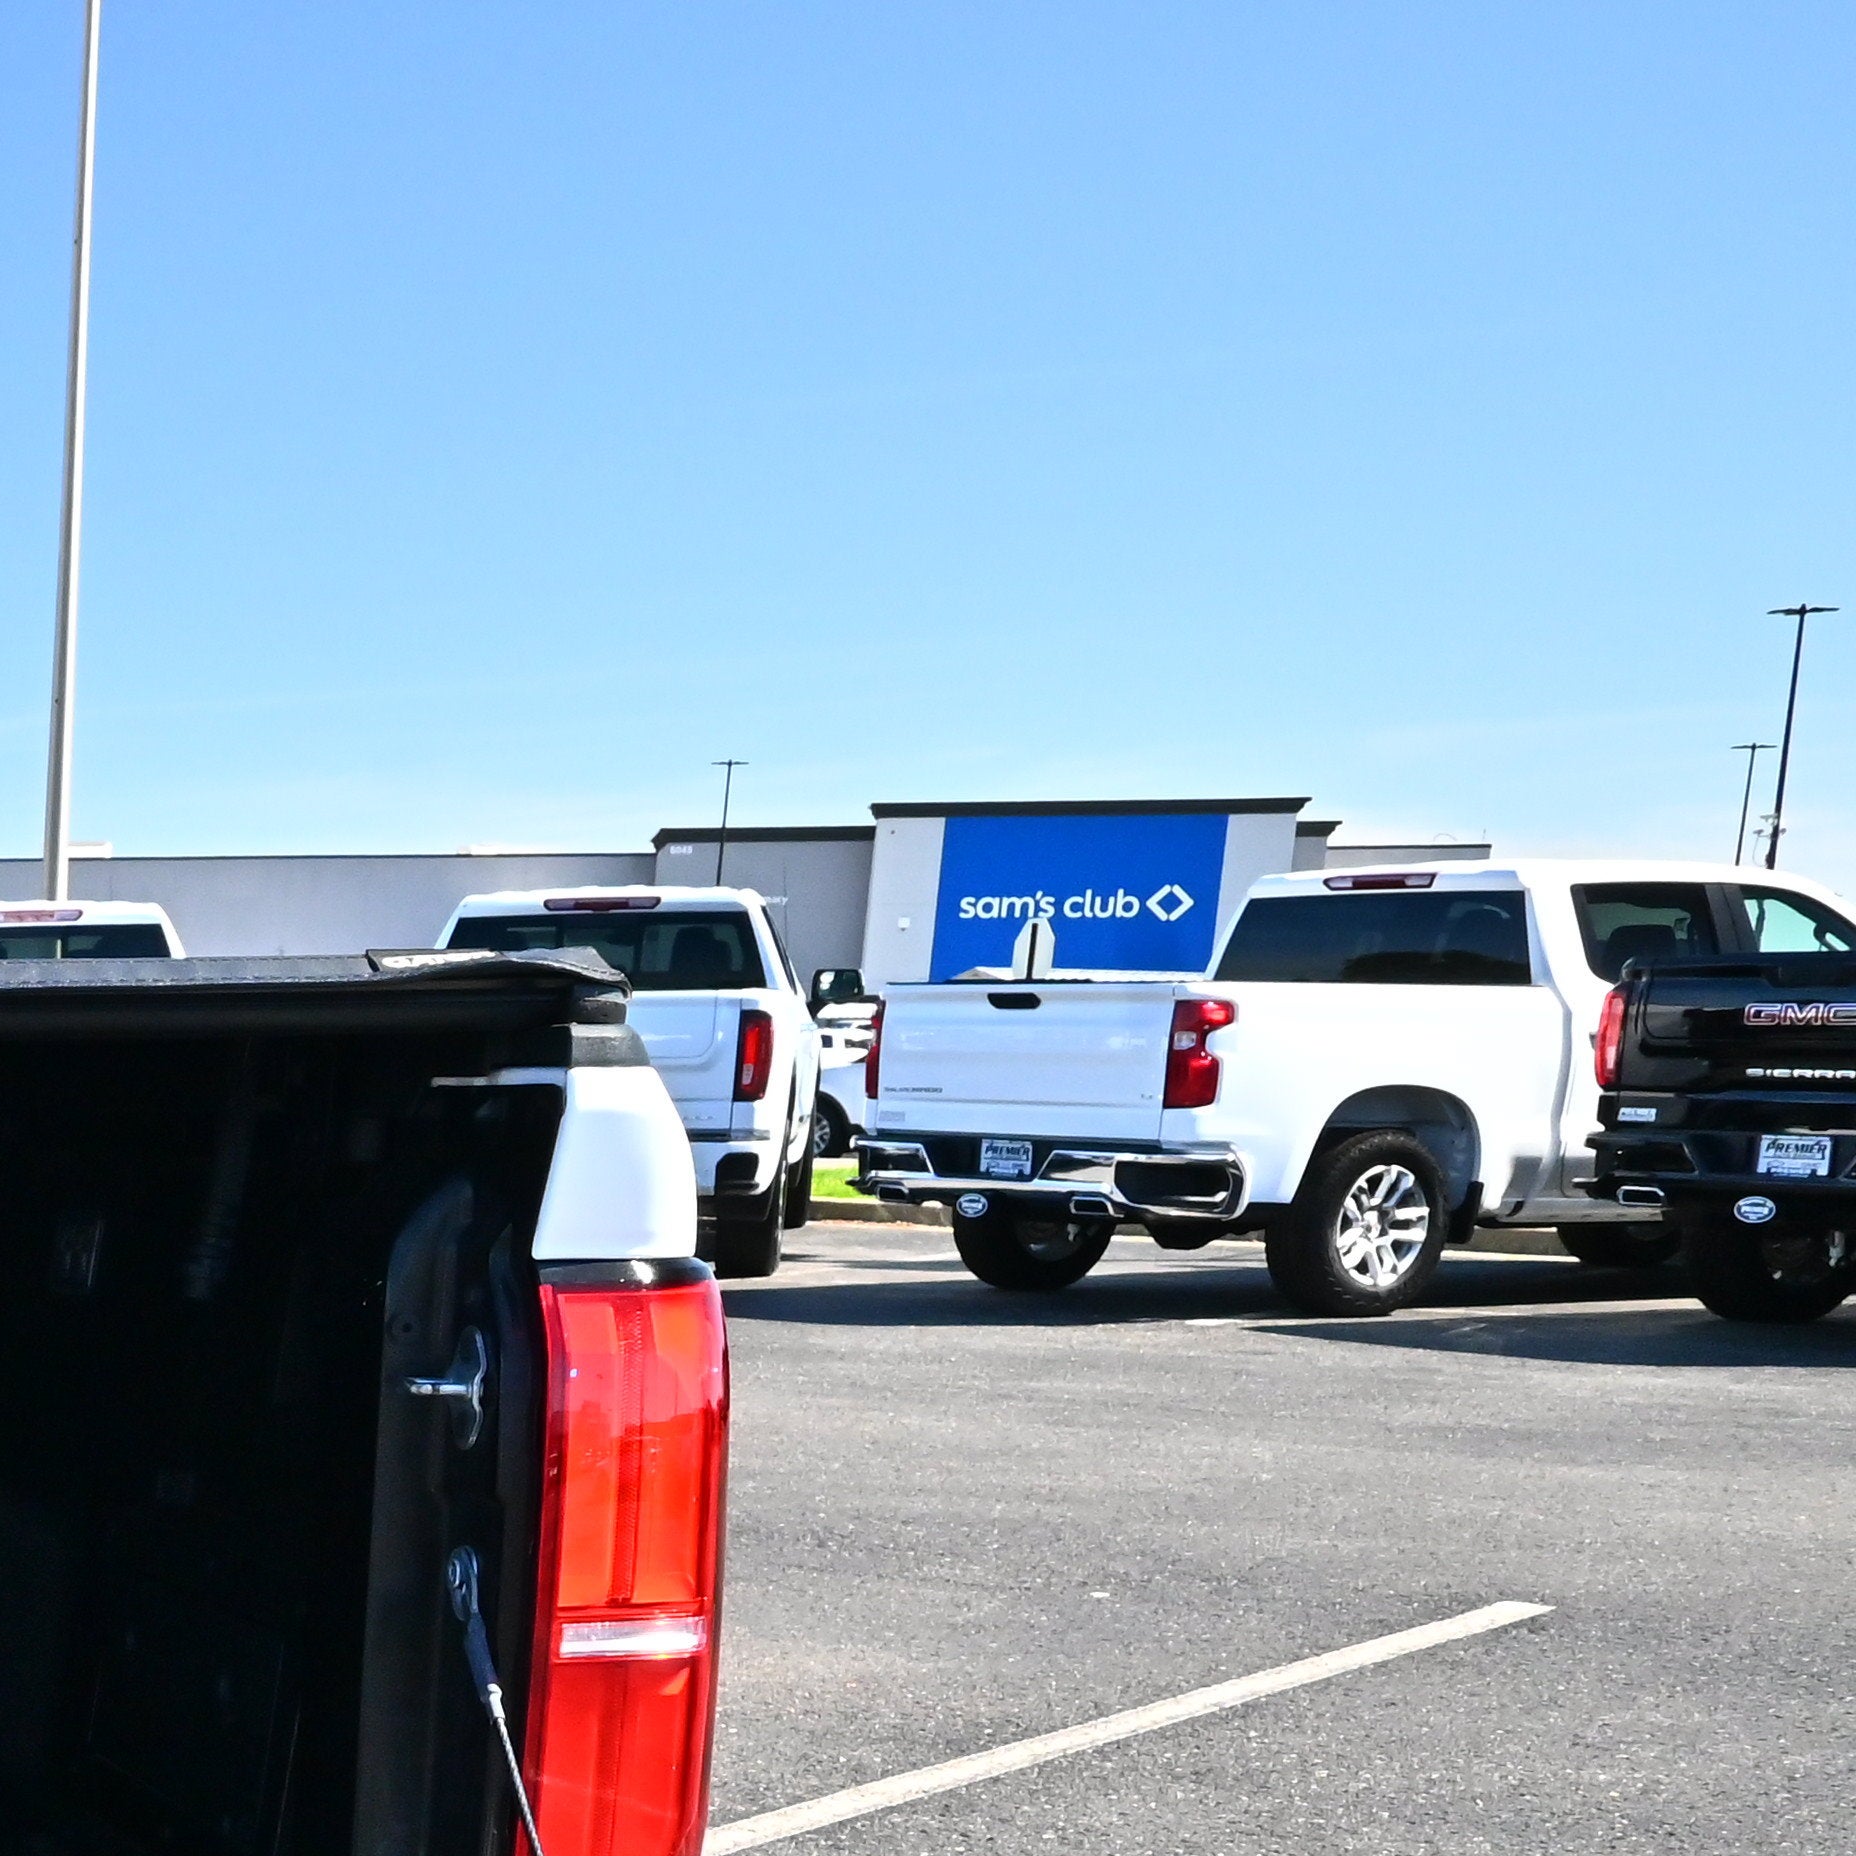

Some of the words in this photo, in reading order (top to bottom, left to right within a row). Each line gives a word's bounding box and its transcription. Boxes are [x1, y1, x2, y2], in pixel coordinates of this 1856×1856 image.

[958, 890, 1056, 919] sam's
[1063, 888, 1141, 919] club
[1744, 1003, 1856, 1026] GMC
[1745, 1067, 1856, 1079] SIERRA
[1764, 1138, 1828, 1158] PREMIER
